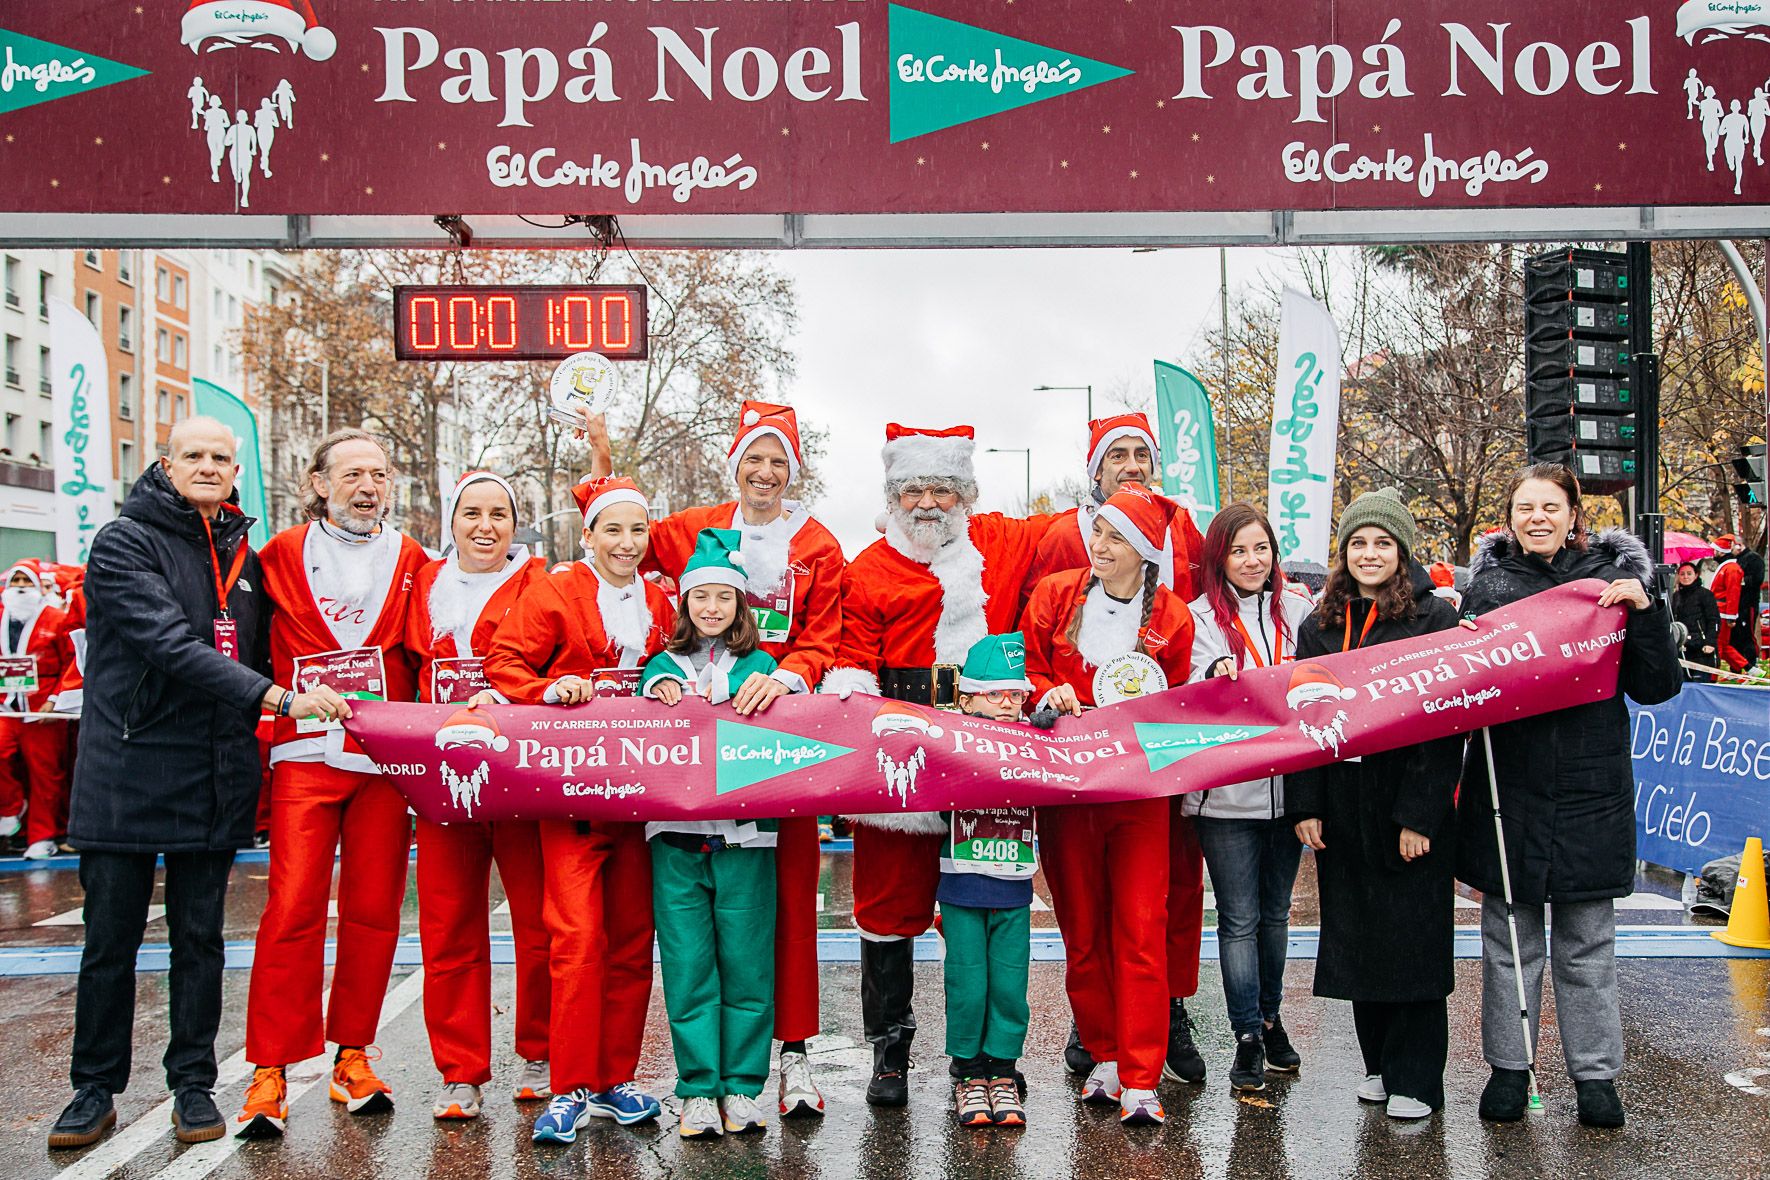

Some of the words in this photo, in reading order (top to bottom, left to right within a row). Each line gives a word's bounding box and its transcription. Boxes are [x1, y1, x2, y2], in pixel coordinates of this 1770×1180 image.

[1, 46, 97, 93] Inglés
[373, 21, 622, 127] Papá
[647, 21, 869, 102] Noel
[897, 53, 925, 84] El
[926, 53, 989, 84] Corte
[990, 49, 1082, 94] Inglés
[1171, 18, 1414, 124] Papá
[1440, 15, 1658, 98] Noel
[487, 146, 526, 188] El
[528, 147, 621, 189] Corte
[624, 138, 758, 204] Inglés
[1281, 141, 1322, 183] El
[1323, 143, 1414, 183] Corte
[1417, 132, 1549, 198] Inglés
[1368, 662, 1388, 676] XIV
[1389, 647, 1443, 667] CARRERA
[1442, 627, 1503, 652] SOLIDARIA
[1502, 621, 1519, 632] DE
[1577, 628, 1627, 654] MADRID
[1361, 657, 1459, 703] Papá
[1457, 630, 1547, 675] Noel
[1423, 699, 1437, 715] El
[1435, 695, 1463, 712] Corte
[1461, 686, 1502, 710] Inglés
[531, 720, 551, 730] XIV
[553, 719, 609, 730] CARRERA
[610, 719, 672, 729] SOLIDARIA
[674, 719, 691, 728] DE
[961, 720, 980, 729] XIV
[982, 723, 1033, 740] CARRERA
[1033, 732, 1093, 744] SOLIDARIA
[1094, 729, 1110, 740] DE
[1630, 710, 1669, 763] De
[1671, 713, 1697, 766] la
[1701, 716, 1770, 781] Base
[515, 735, 609, 777] Papá
[618, 735, 703, 767] Noel
[720, 744, 737, 762] El
[737, 744, 774, 761] Corte
[773, 739, 828, 766] Inglés
[950, 729, 1041, 762] Papá
[1044, 740, 1131, 767] Noel
[562, 782, 576, 796] El
[575, 782, 605, 796] Corte
[604, 778, 646, 800] Inglés
[1000, 766, 1013, 781] El
[1012, 767, 1042, 781] Corte
[1645, 783, 1711, 847] Cielo
[971, 839, 1019, 862] 9408
